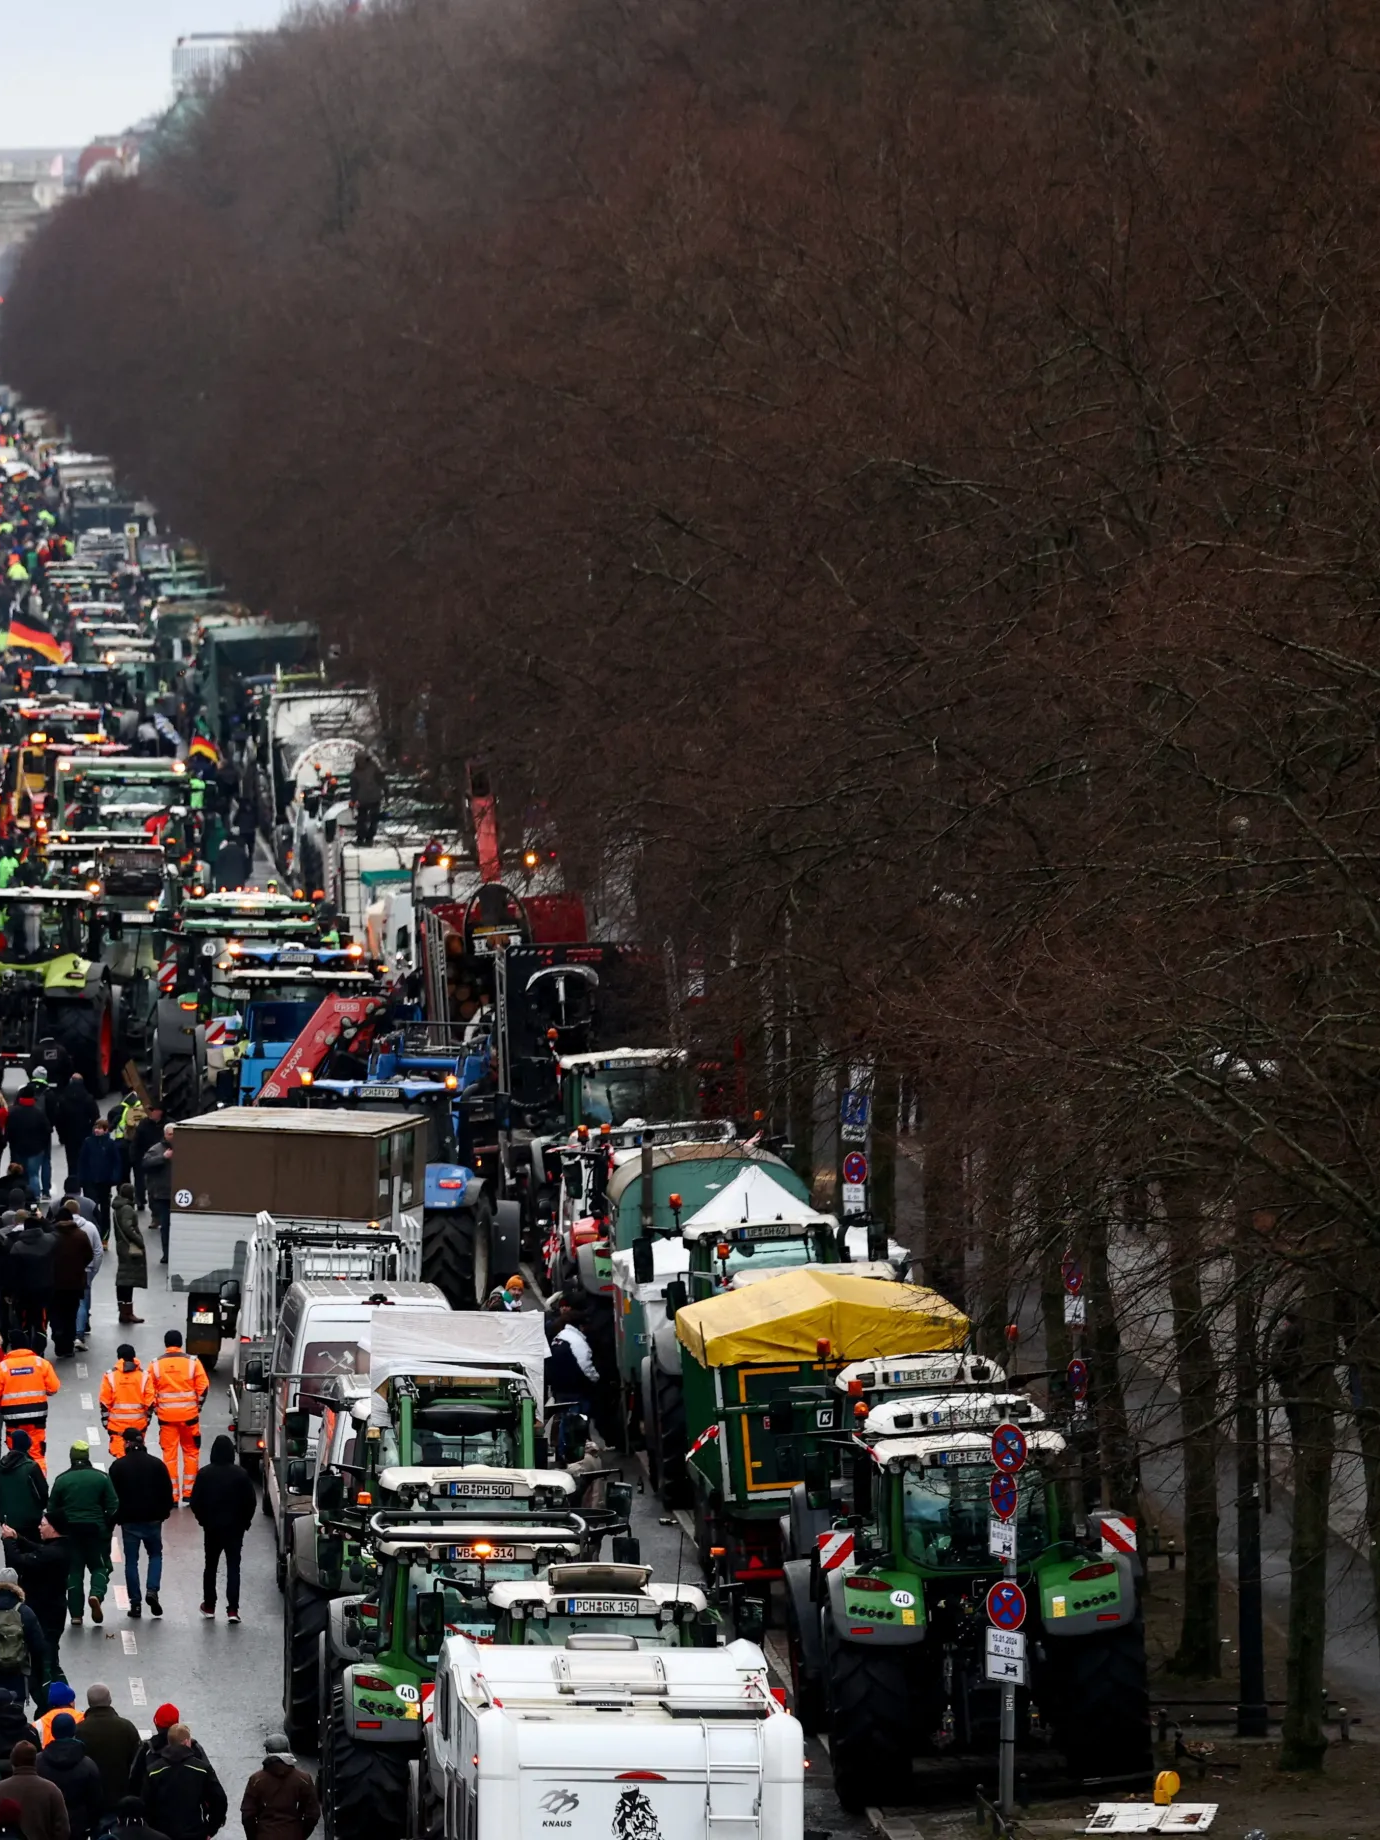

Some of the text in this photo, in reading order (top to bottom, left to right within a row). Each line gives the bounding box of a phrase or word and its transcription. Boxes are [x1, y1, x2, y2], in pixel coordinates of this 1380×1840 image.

[178, 1192, 190, 1204] 25
[456, 1484, 511, 1495] WB PH 500
[456, 1547, 513, 1558] WB 314
[895, 1593, 910, 1604] 40
[576, 1601, 637, 1612] PCH GK 156
[992, 1634, 1018, 1646] 15.01.2024
[400, 1686, 416, 1698] 40
[542, 1820, 572, 1828] KNAUS
